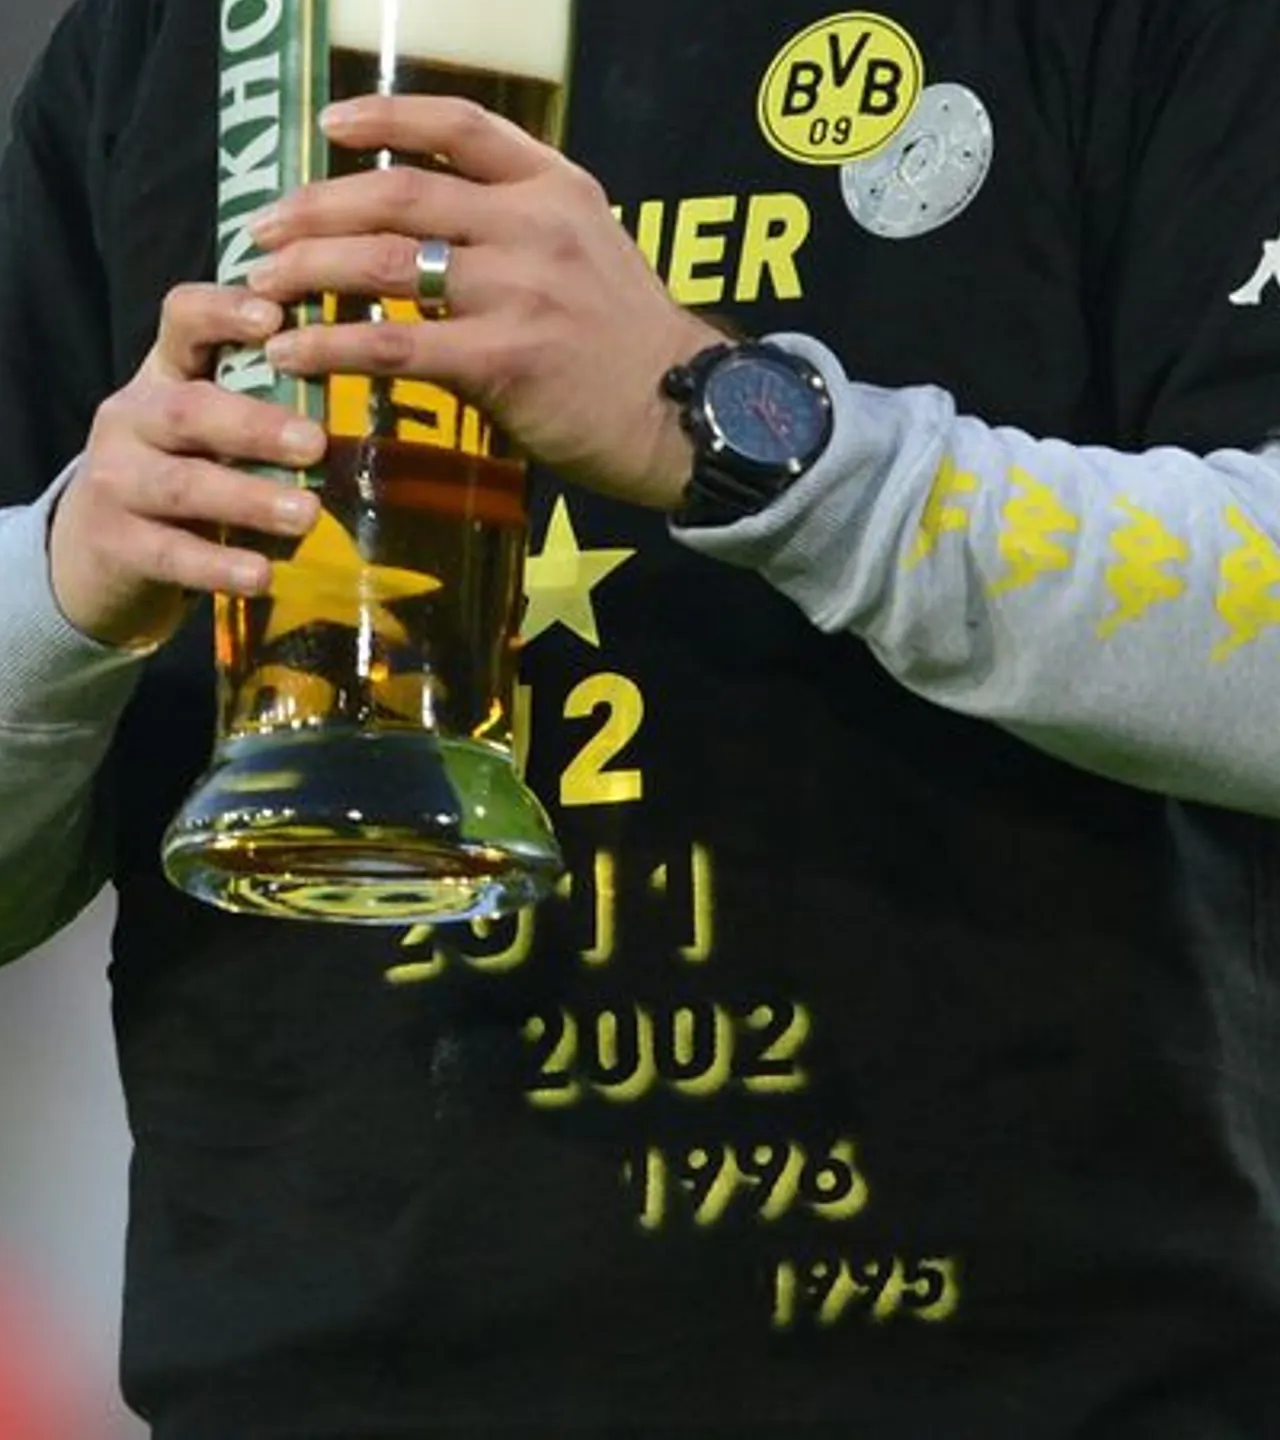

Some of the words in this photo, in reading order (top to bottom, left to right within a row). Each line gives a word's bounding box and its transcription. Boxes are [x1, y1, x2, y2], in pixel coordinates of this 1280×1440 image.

[781, 32, 902, 117] BVB
[808, 117, 853, 146] 09
[520, 1000, 811, 1107] 2002
[625, 1138, 870, 1230] 1996
[770, 1256, 961, 1328] 1995
